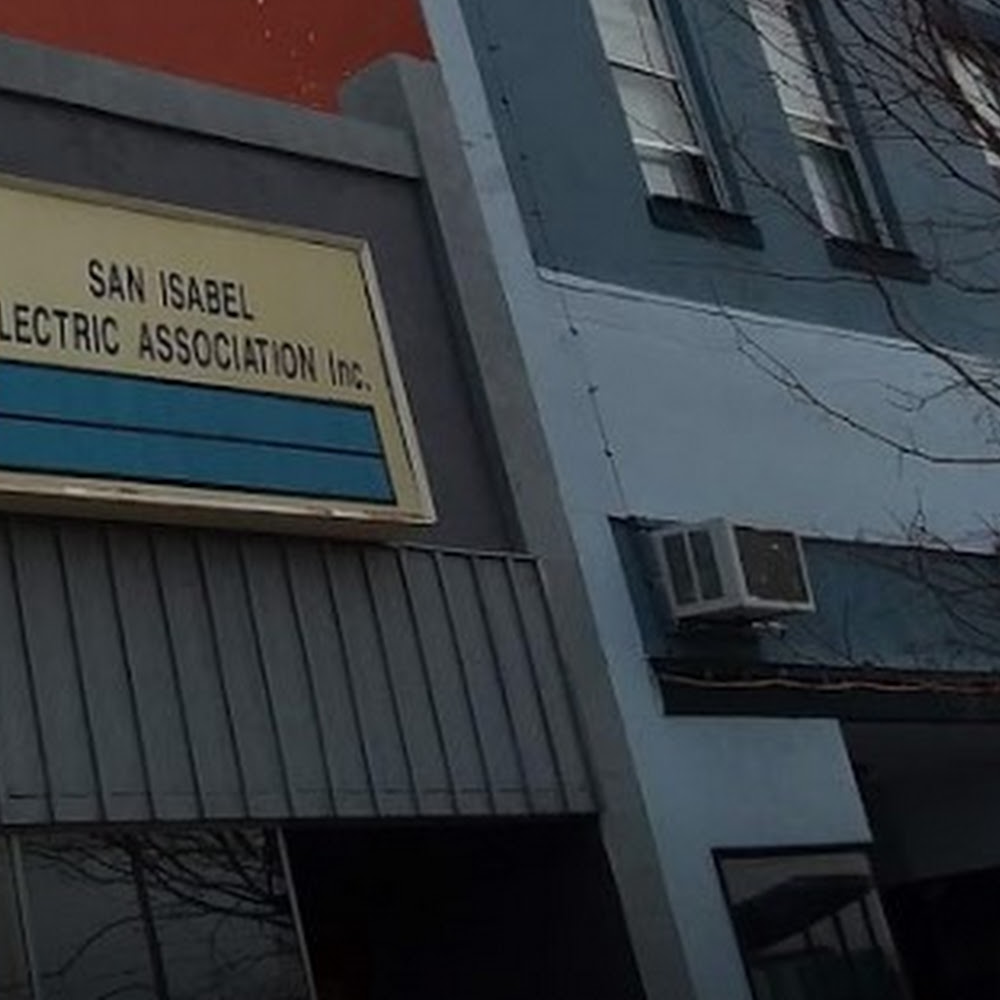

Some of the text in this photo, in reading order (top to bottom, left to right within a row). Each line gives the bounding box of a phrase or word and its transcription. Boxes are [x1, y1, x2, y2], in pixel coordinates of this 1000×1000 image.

[88, 258, 255, 322] SAN ISABEL
[139, 322, 318, 384] ASSOCIATION
[328, 349, 373, 393] Inc.
